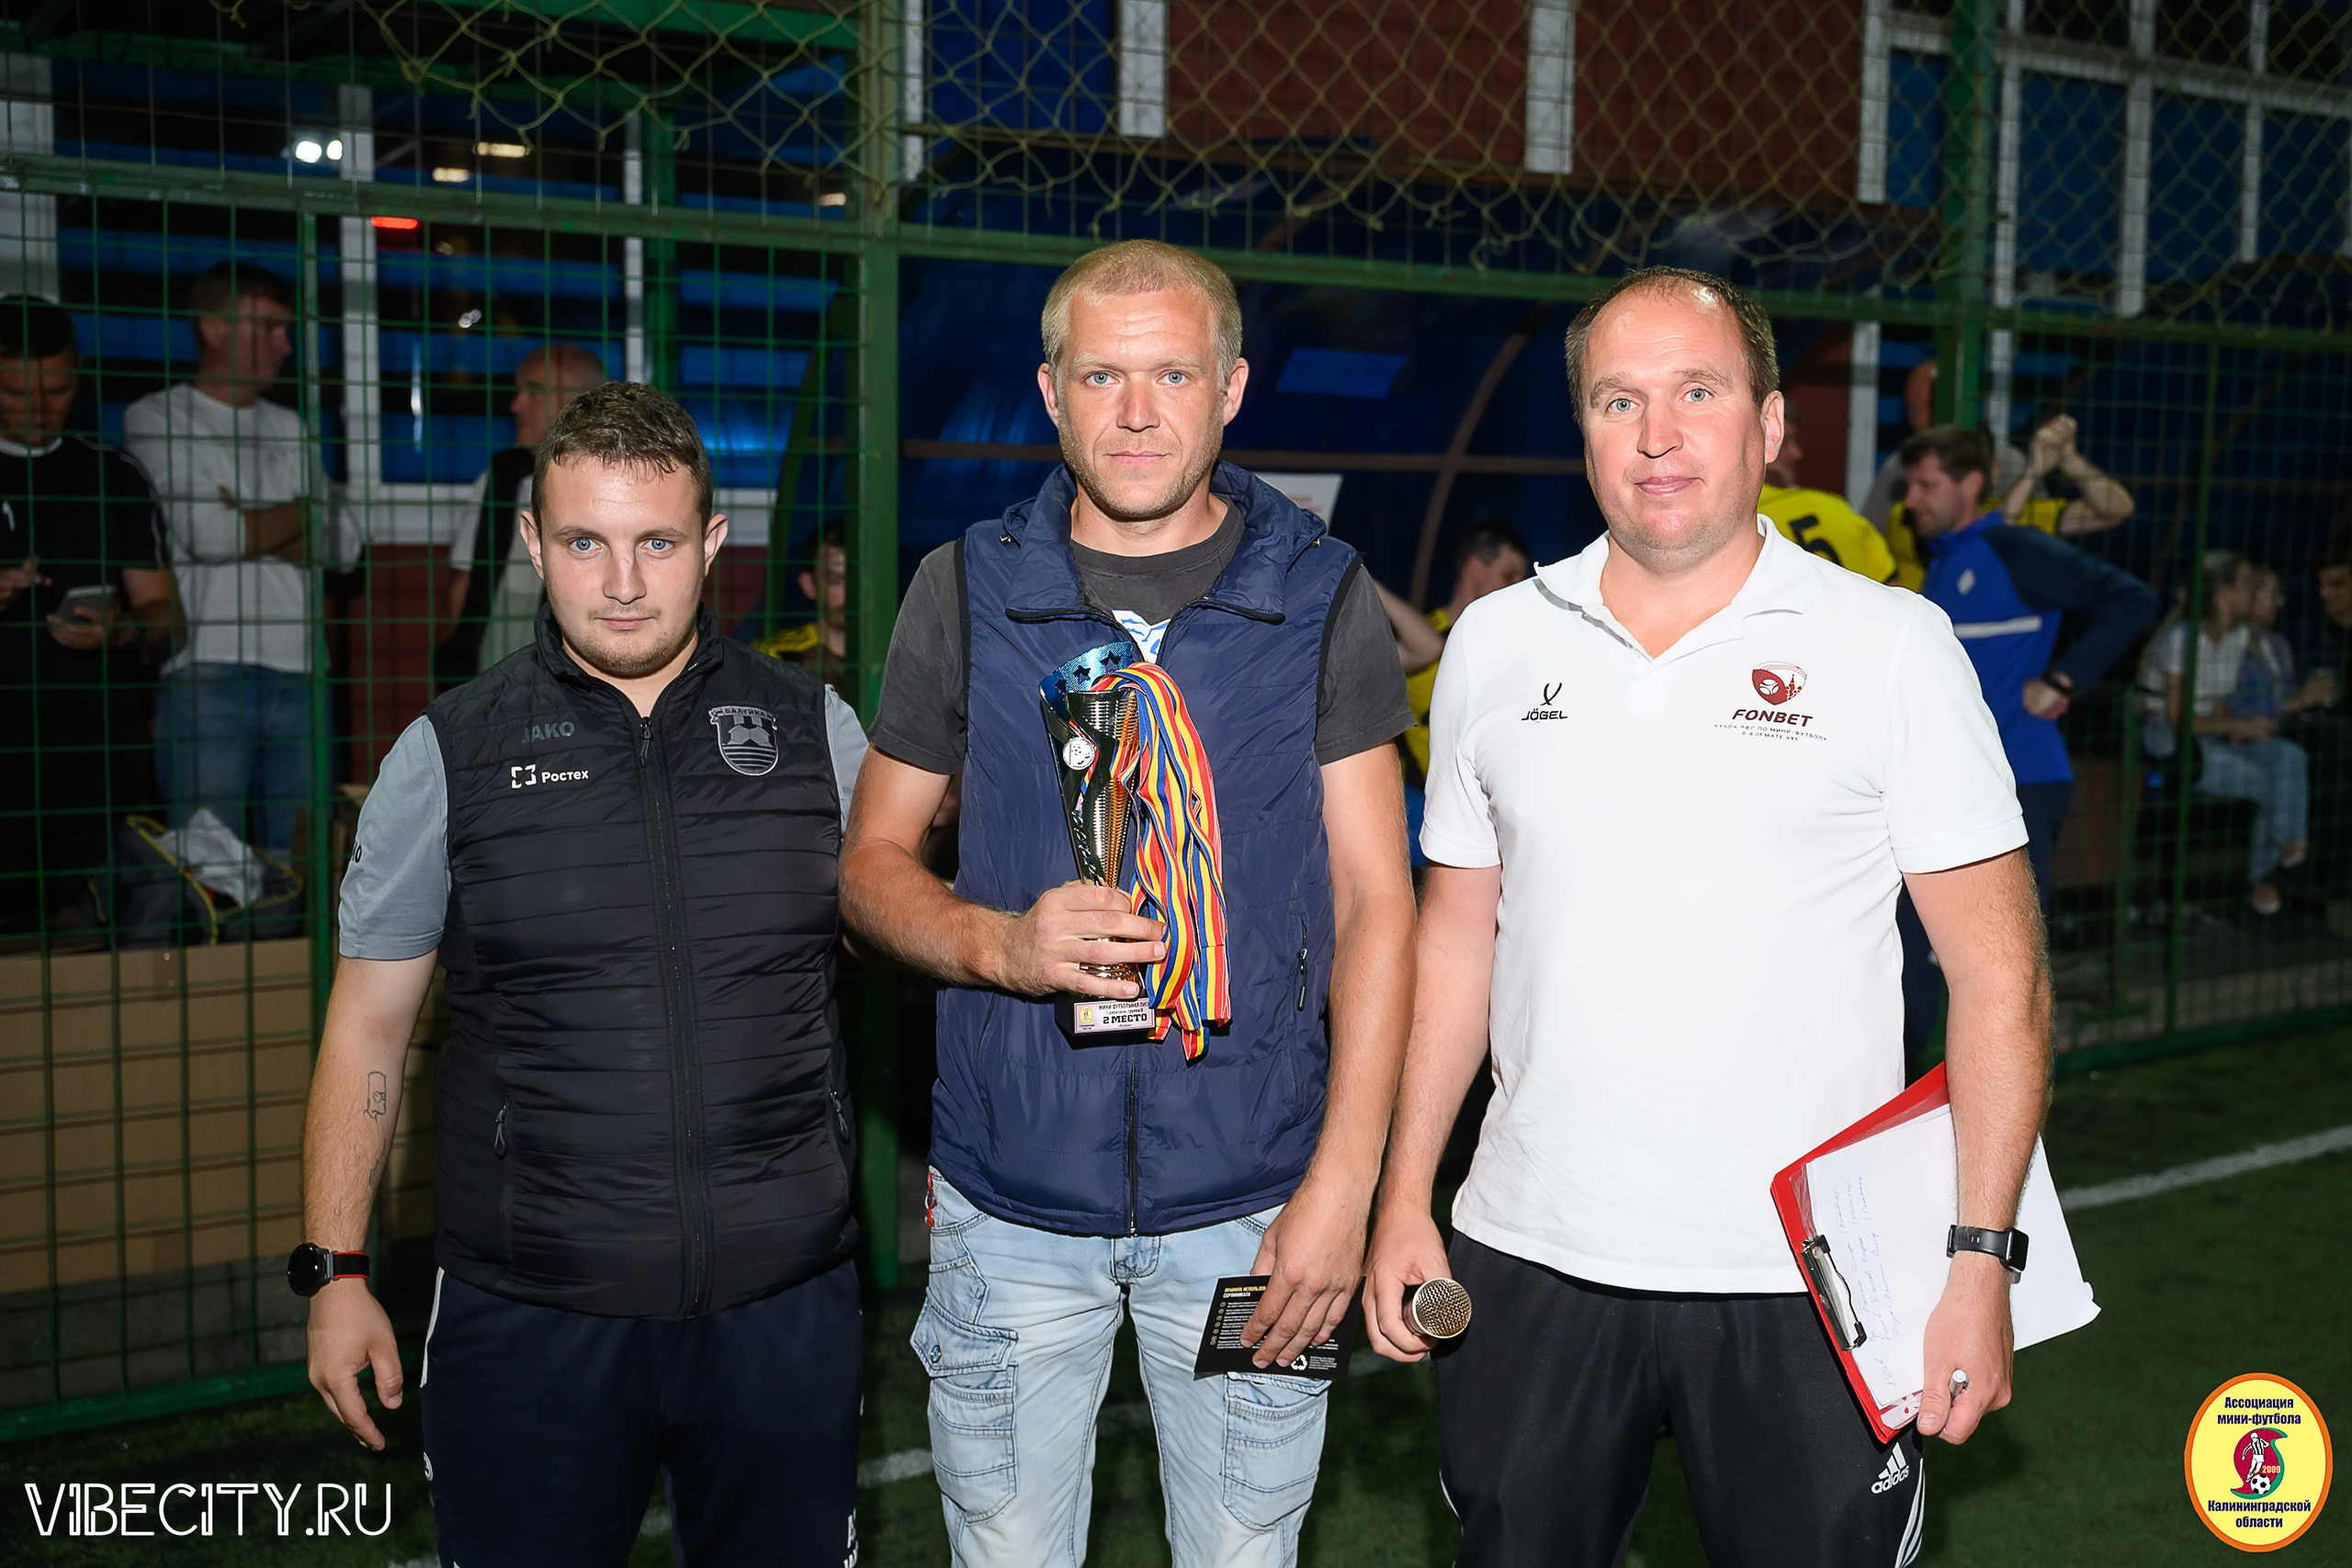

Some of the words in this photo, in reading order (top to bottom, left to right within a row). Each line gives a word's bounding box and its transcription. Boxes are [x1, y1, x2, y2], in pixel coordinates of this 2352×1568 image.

[724, 708, 765, 717] БАЛТИКА
[1521, 707, 1568, 721] JÖGEL
[1732, 709, 1813, 727] FONBET
[521, 721, 575, 744] JAKO
[541, 771, 589, 784] Ростех
[1102, 1016, 1110, 1024] 2
[1111, 1013, 1148, 1024] МЕСТО
[1871, 1465, 1909, 1495] adidas
